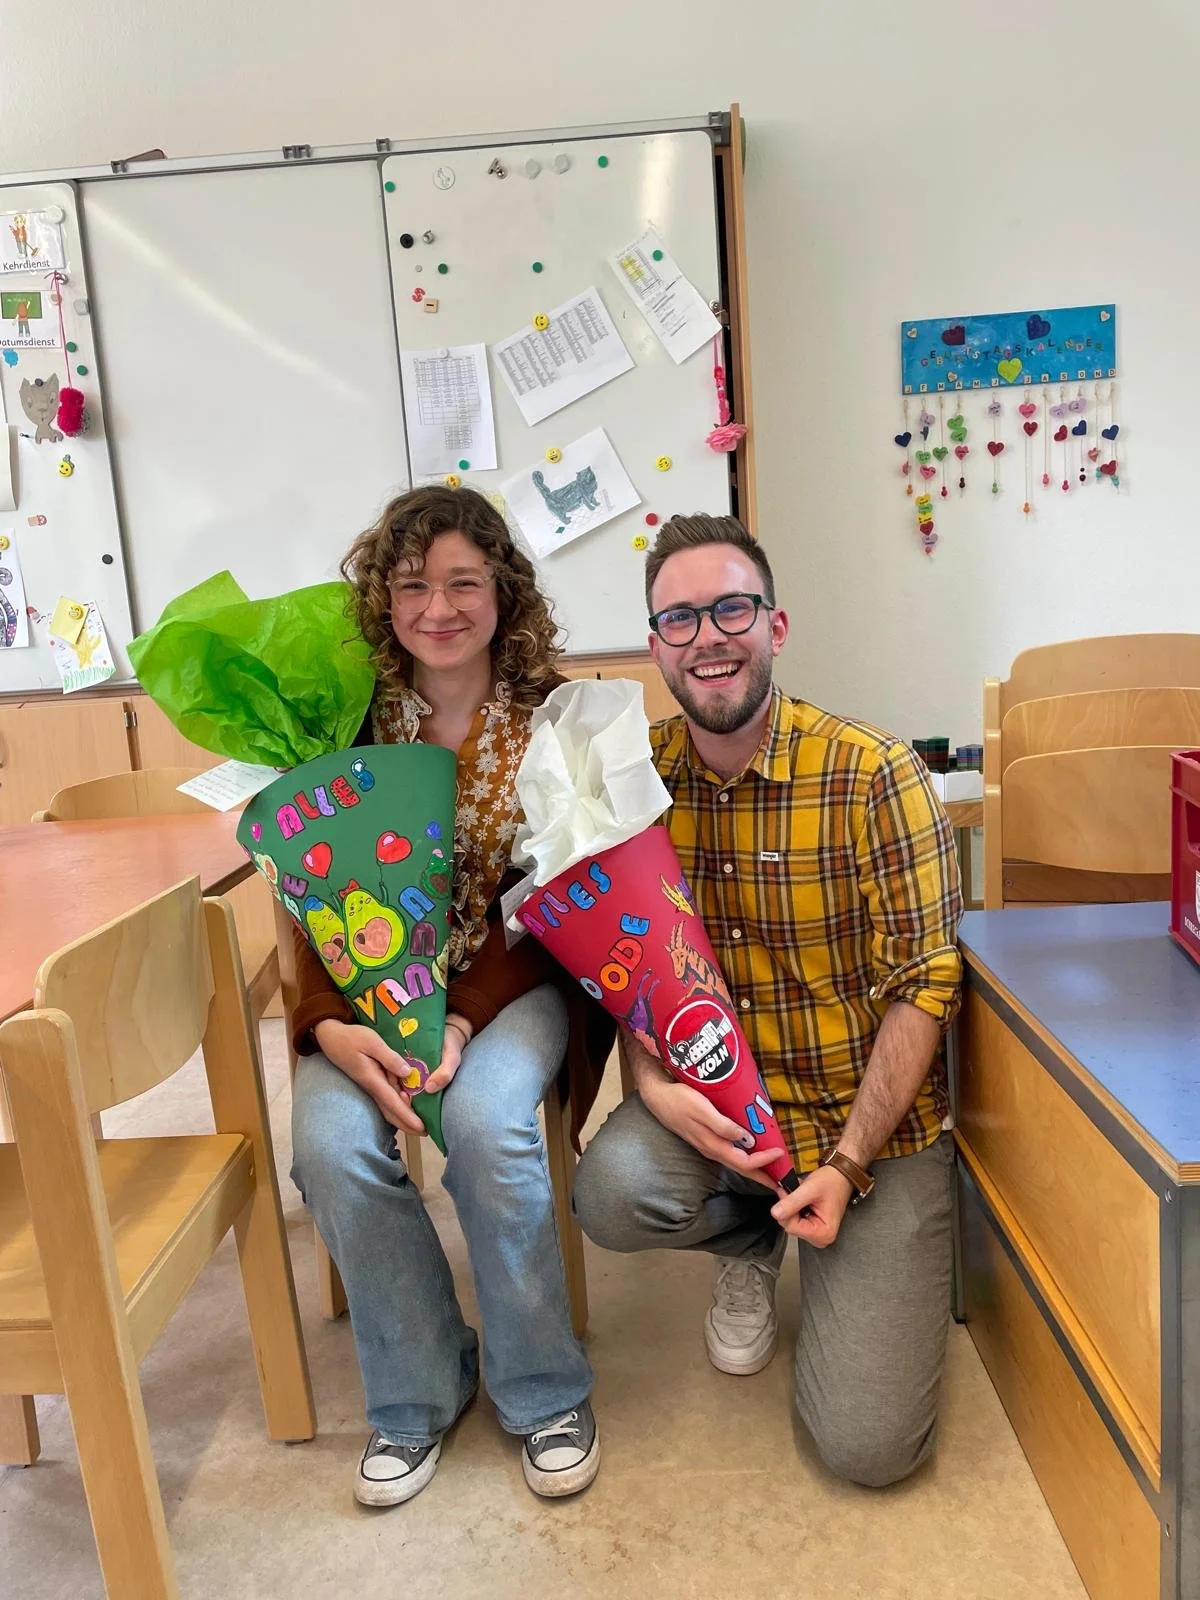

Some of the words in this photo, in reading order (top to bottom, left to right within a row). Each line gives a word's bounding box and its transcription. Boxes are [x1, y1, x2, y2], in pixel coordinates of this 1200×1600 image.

[3, 260, 50, 271] Kehrdienst
[276, 757, 375, 841] ALLES
[522, 861, 611, 938] ALLES
[697, 1046, 730, 1081] KÖLN
